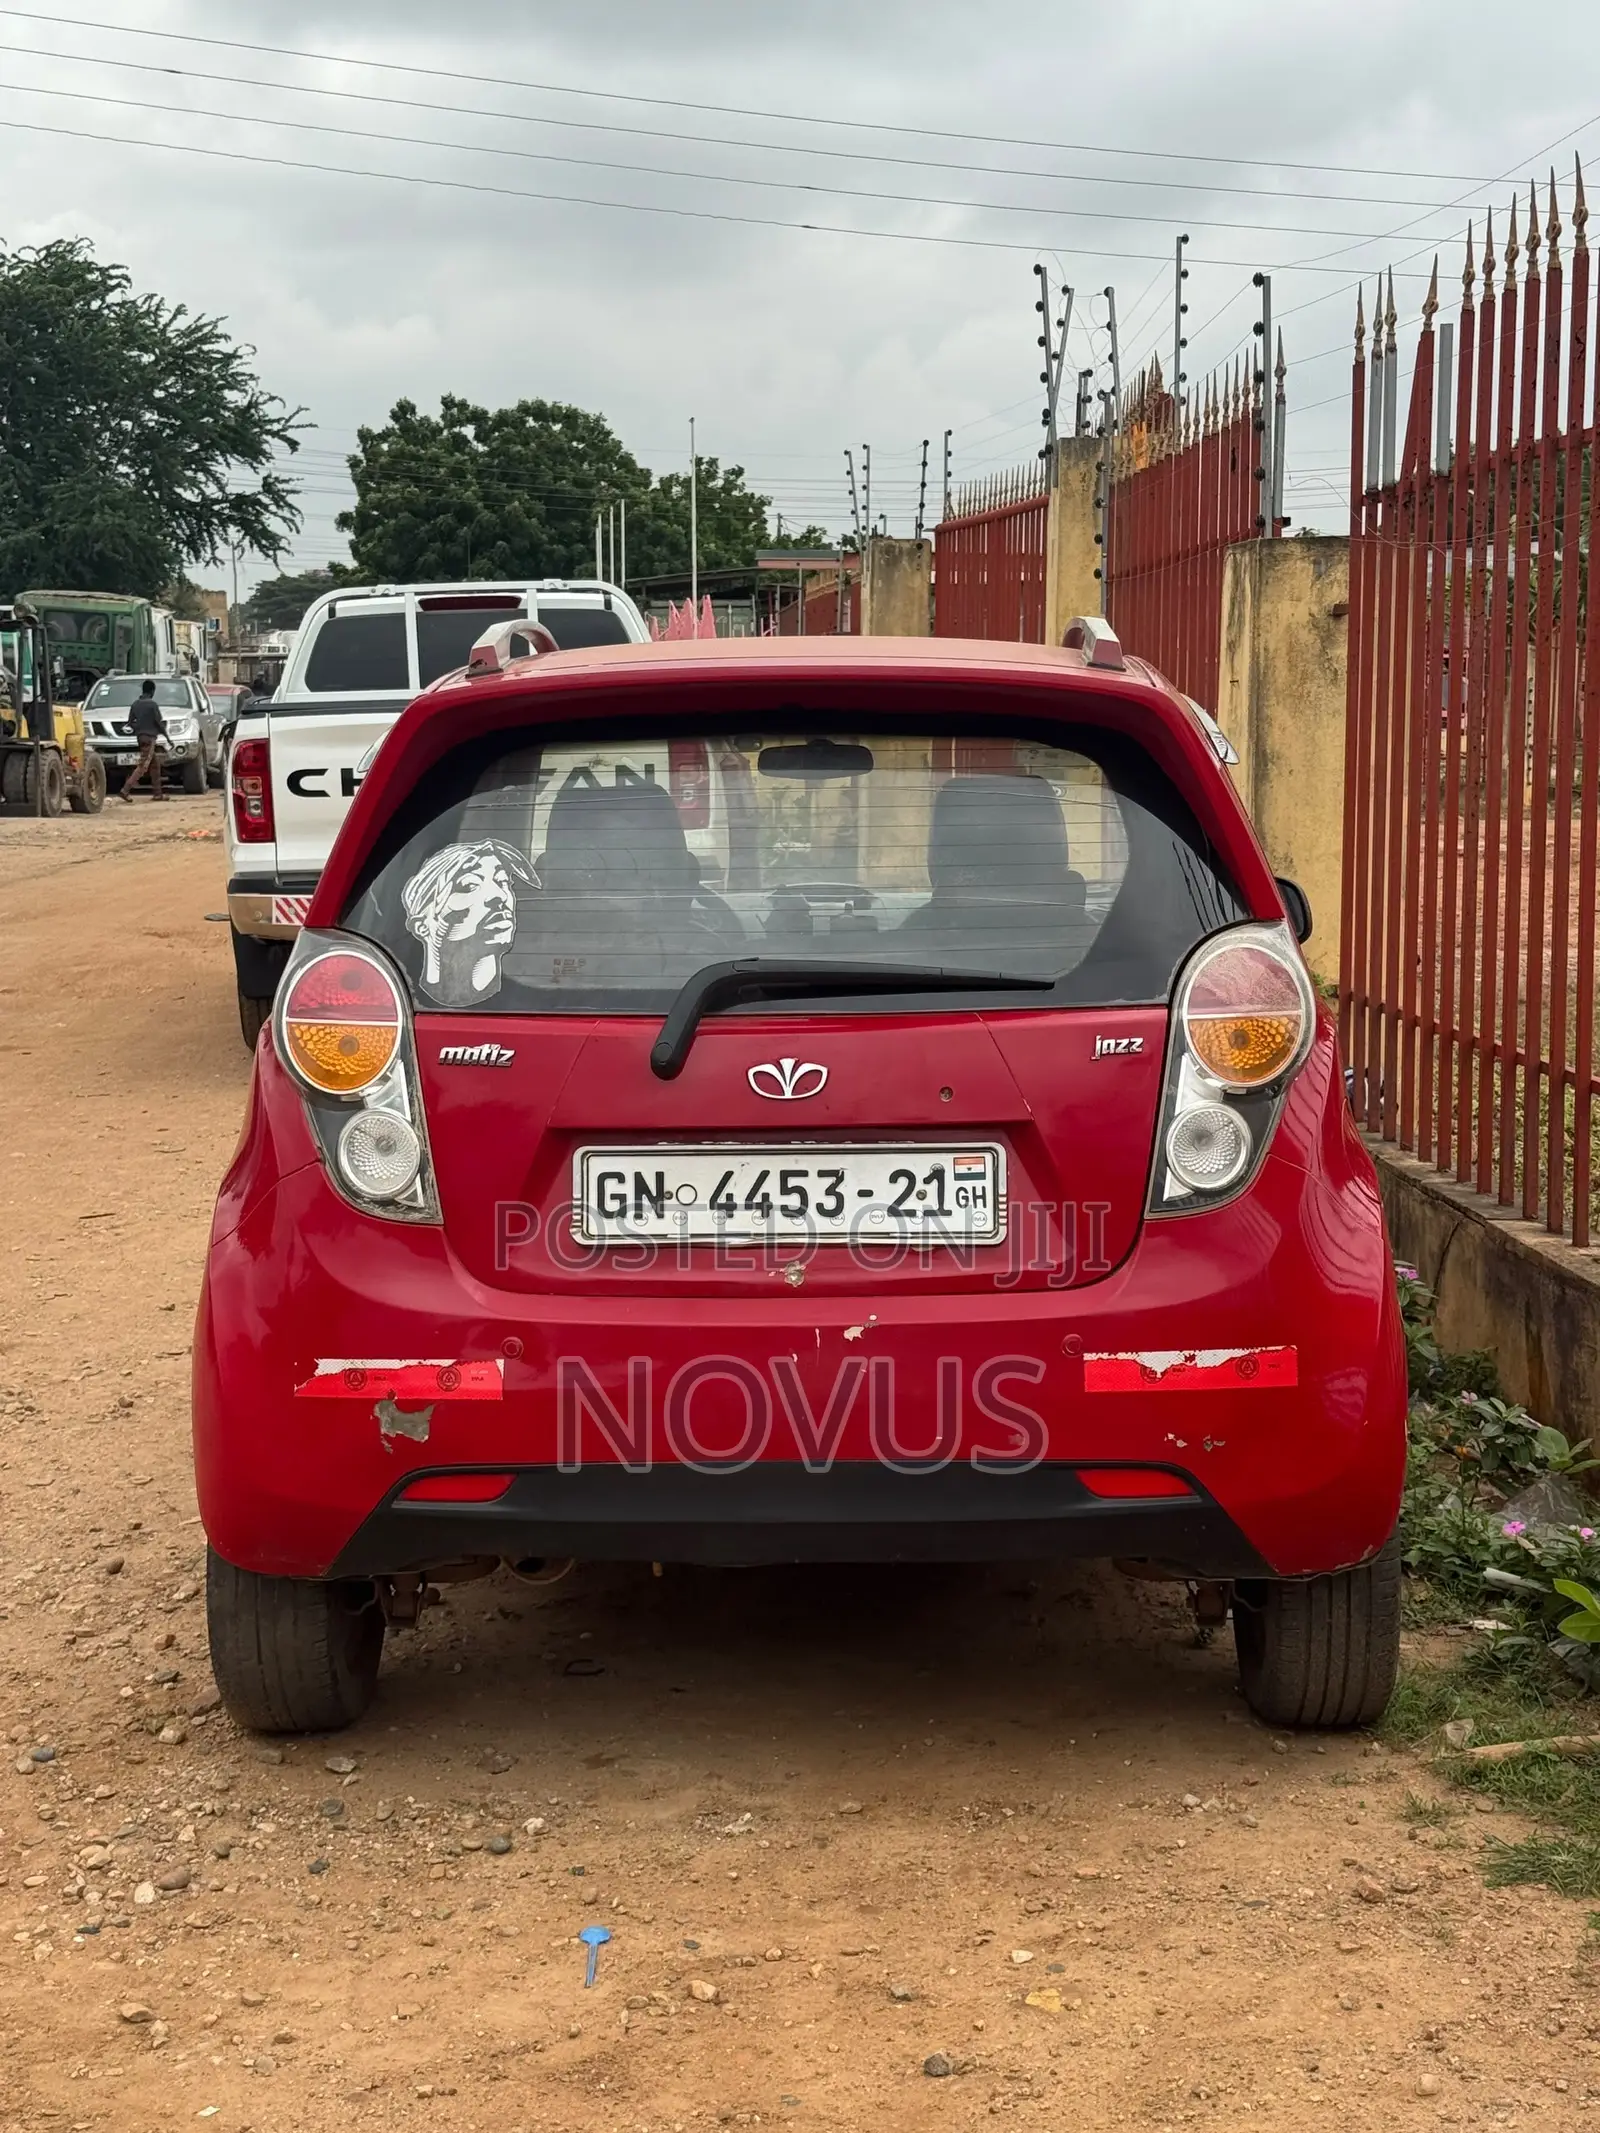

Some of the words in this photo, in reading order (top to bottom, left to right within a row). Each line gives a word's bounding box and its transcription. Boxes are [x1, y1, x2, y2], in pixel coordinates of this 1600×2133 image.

[439, 1043, 516, 1067] matiz
[1090, 1034, 1144, 1060] jazz
[596, 1171, 665, 1219] GN
[955, 1185, 987, 1209] GH
